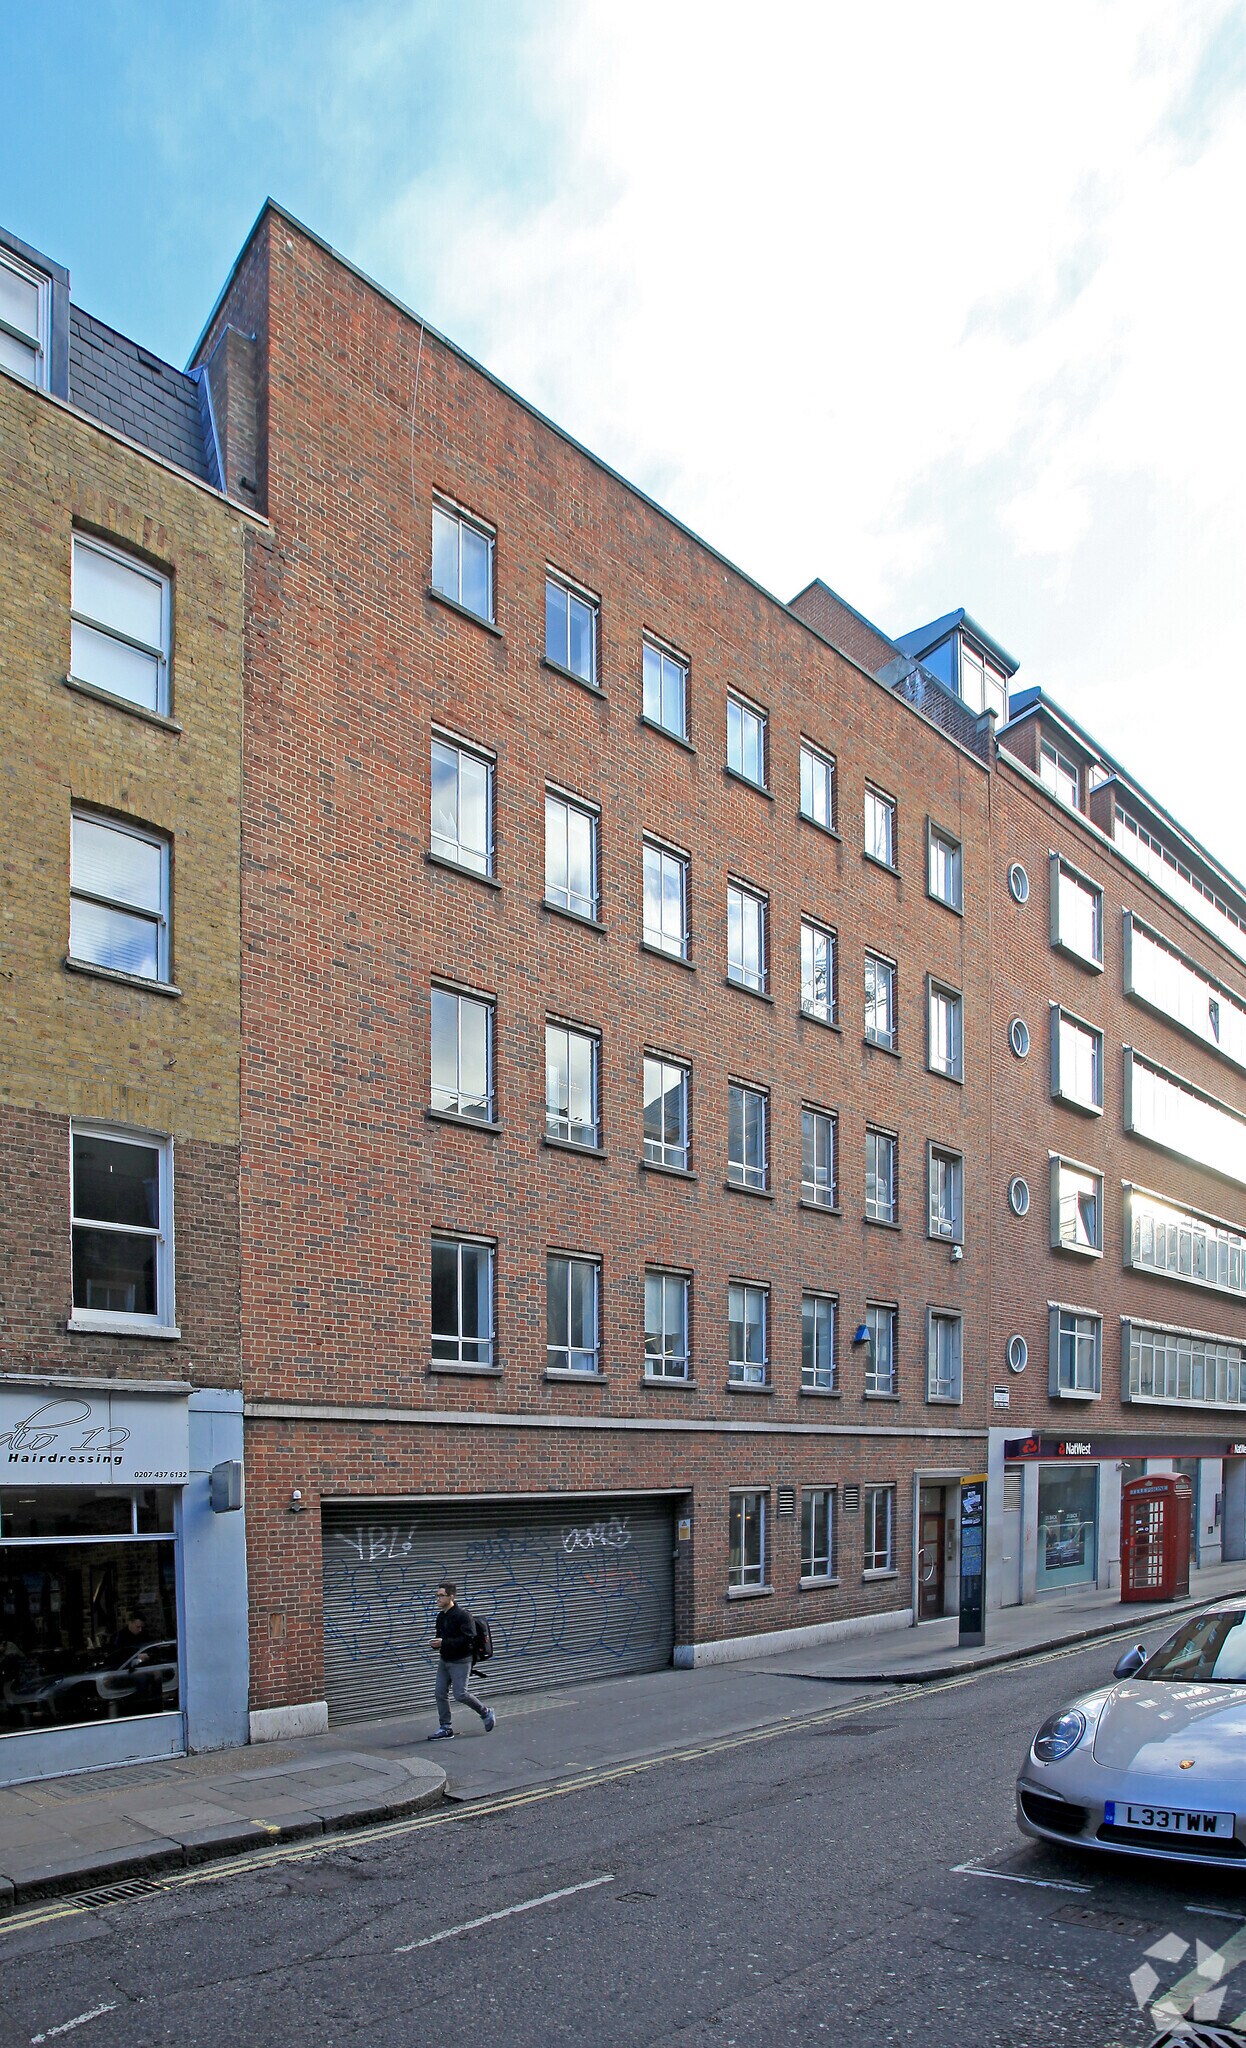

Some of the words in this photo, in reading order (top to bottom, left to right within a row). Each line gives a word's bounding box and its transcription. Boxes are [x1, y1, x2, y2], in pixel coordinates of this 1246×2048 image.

[70, 1426, 131, 1451] 12
[1065, 1442, 1091, 1455] NatWest
[8, 1453, 124, 1465] Hairdressing
[1127, 1806, 1217, 1833] L33TWW
